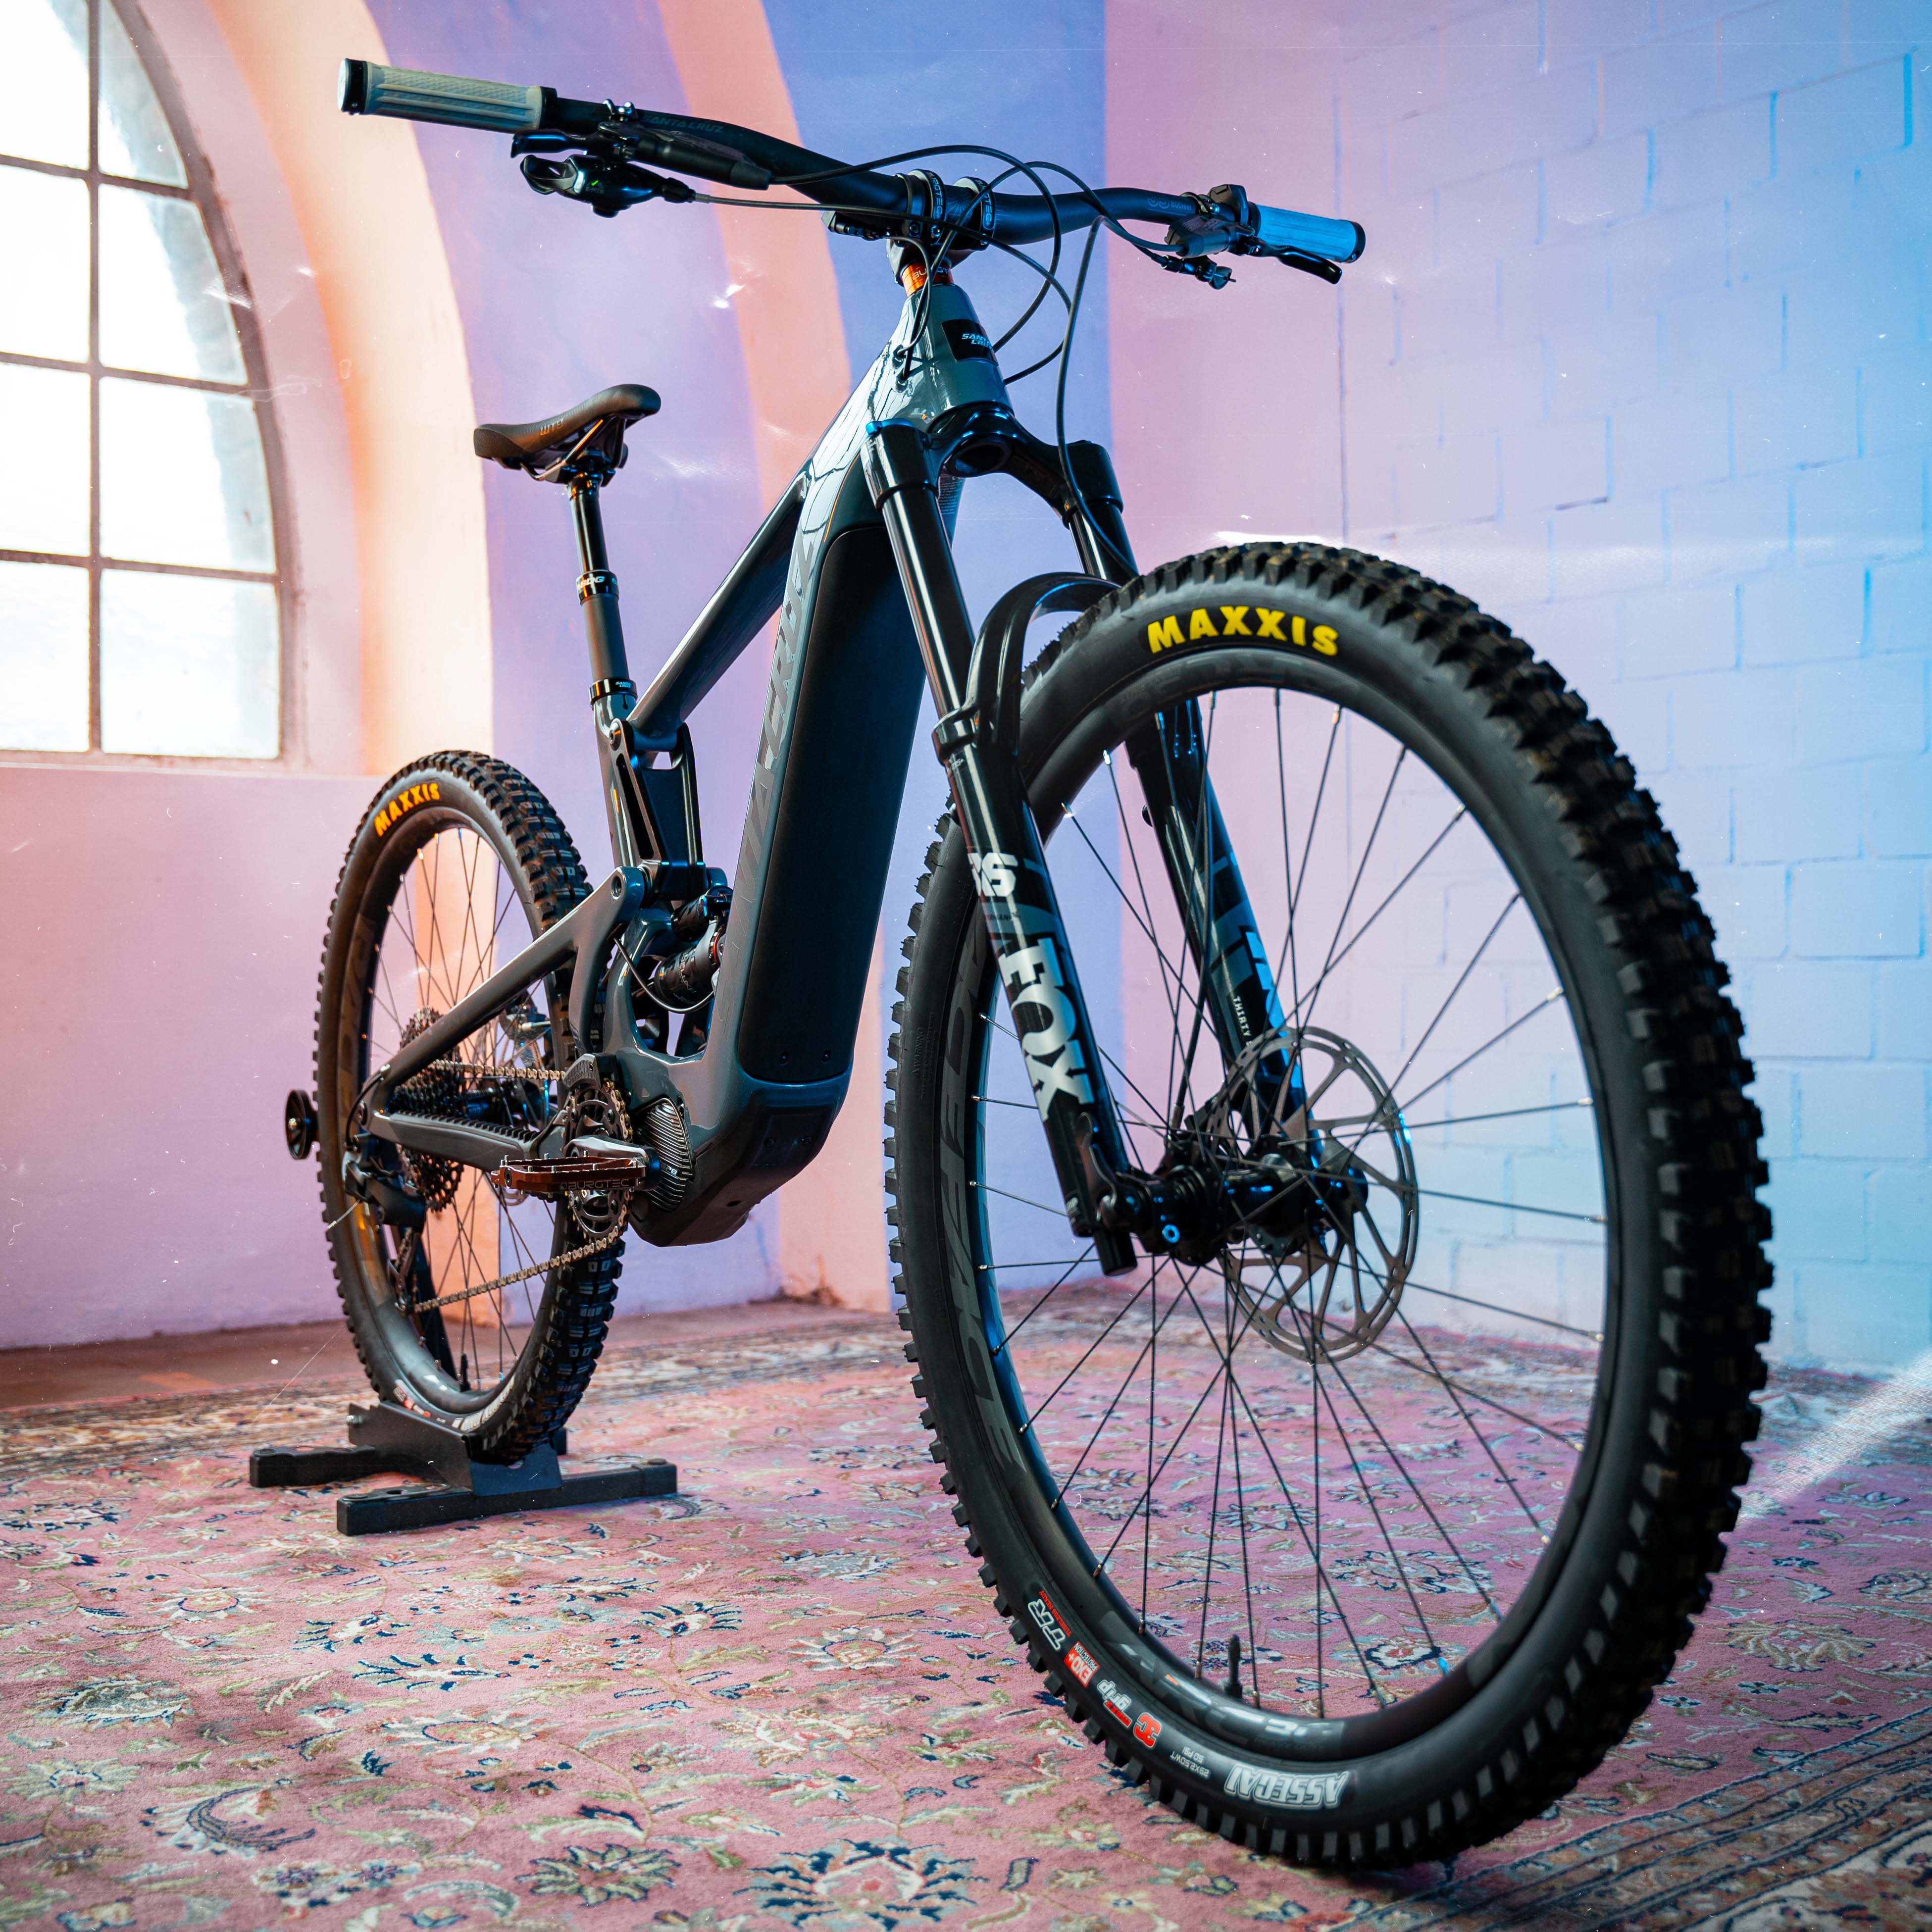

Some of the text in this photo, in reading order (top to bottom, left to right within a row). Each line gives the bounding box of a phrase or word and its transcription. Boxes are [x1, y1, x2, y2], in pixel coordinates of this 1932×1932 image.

[689, 122, 724, 133] CRUZ
[762, 532, 815, 760] CRUZ
[1147, 606, 1338, 656] MAXXIS
[374, 782, 440, 837] MAXXIS
[997, 937, 1094, 1122] FOX
[1232, 996, 1251, 1037] THIRTY
[915, 1027, 924, 1068] WARNING
[567, 1179, 630, 1190] BURGTEC
[1038, 1589, 1054, 1610] READY
[1028, 1598, 1066, 1651] TR
[1068, 1653, 1091, 1684] EXO+
[1073, 1642, 1099, 1671] PROTECTION
[1097, 1679, 1132, 1710] grip
[1182, 1746, 1204, 1764] 50 PSI
[1224, 1763, 1350, 1809] ASSEGAI
